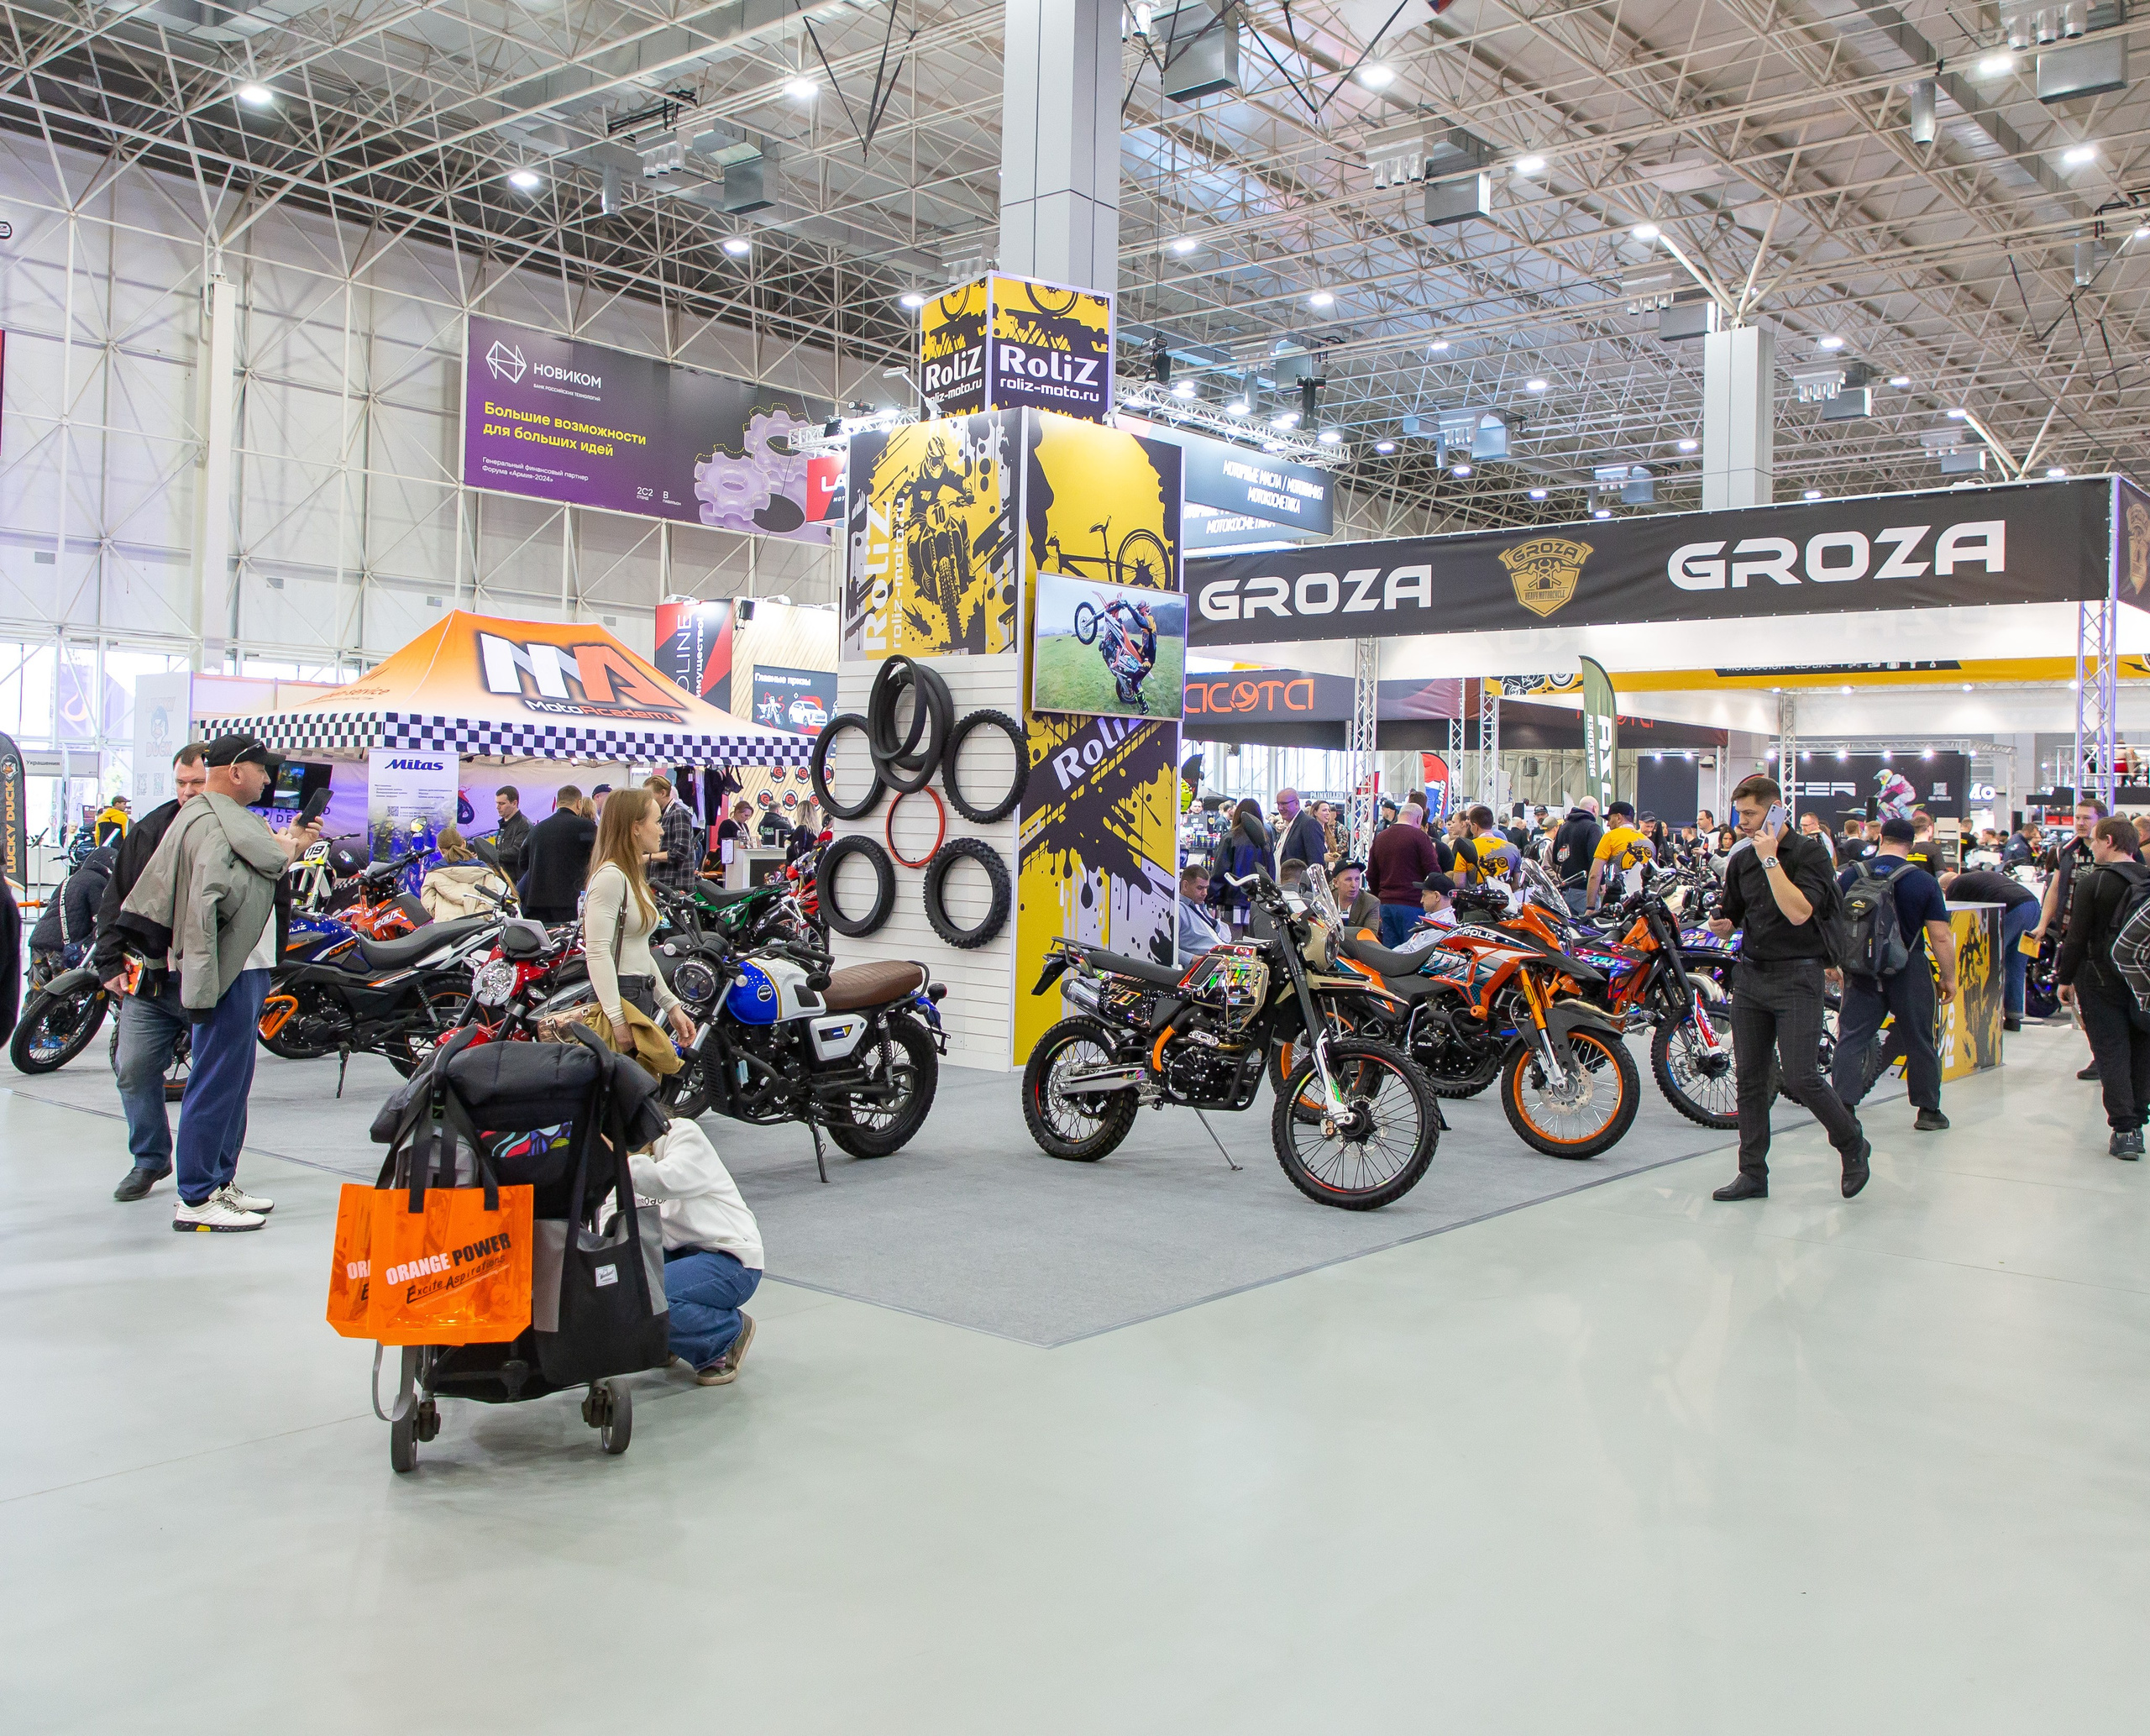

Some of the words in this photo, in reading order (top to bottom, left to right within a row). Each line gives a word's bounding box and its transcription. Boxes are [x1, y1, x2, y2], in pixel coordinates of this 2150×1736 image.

[533, 363, 602, 389] НОВИКОМ
[926, 345, 983, 392] RoliZ
[999, 344, 1099, 386] RoliZ
[929, 379, 983, 404] oliz-moto.ru
[999, 378, 1099, 402] roliz-moto.ru
[483, 423, 511, 438] для
[514, 426, 577, 450] больших
[580, 441, 614, 457] идей
[484, 401, 551, 426] Большие
[553, 417, 647, 445] возможности
[482, 456, 524, 469] Генеральный
[524, 463, 564, 478] финансовый
[564, 471, 589, 482] партнер
[482, 464, 508, 476] Форума
[508, 469, 554, 484] «Армия-2024»
[1513, 542, 1578, 563] GROZA
[1668, 520, 2006, 590] GROZA
[863, 501, 891, 651] RoliZ
[892, 497, 905, 649] roliz-moto.ru
[1198, 564, 1432, 621] GROZA
[1524, 590, 1539, 601] HEAVY
[525, 700, 683, 723] MotoAcademy
[385, 758, 443, 770] Mitas
[5, 780, 15, 821] DUCK
[6, 824, 17, 873] LUCKY
[306, 845, 325, 858] 119
[1462, 928, 1497, 941] ROLIZ
[385, 1252, 451, 1285] ORANGE
[452, 1232, 512, 1267] POWER
[406, 1279, 443, 1304] Excite
[446, 1254, 506, 1291] Aspirations
